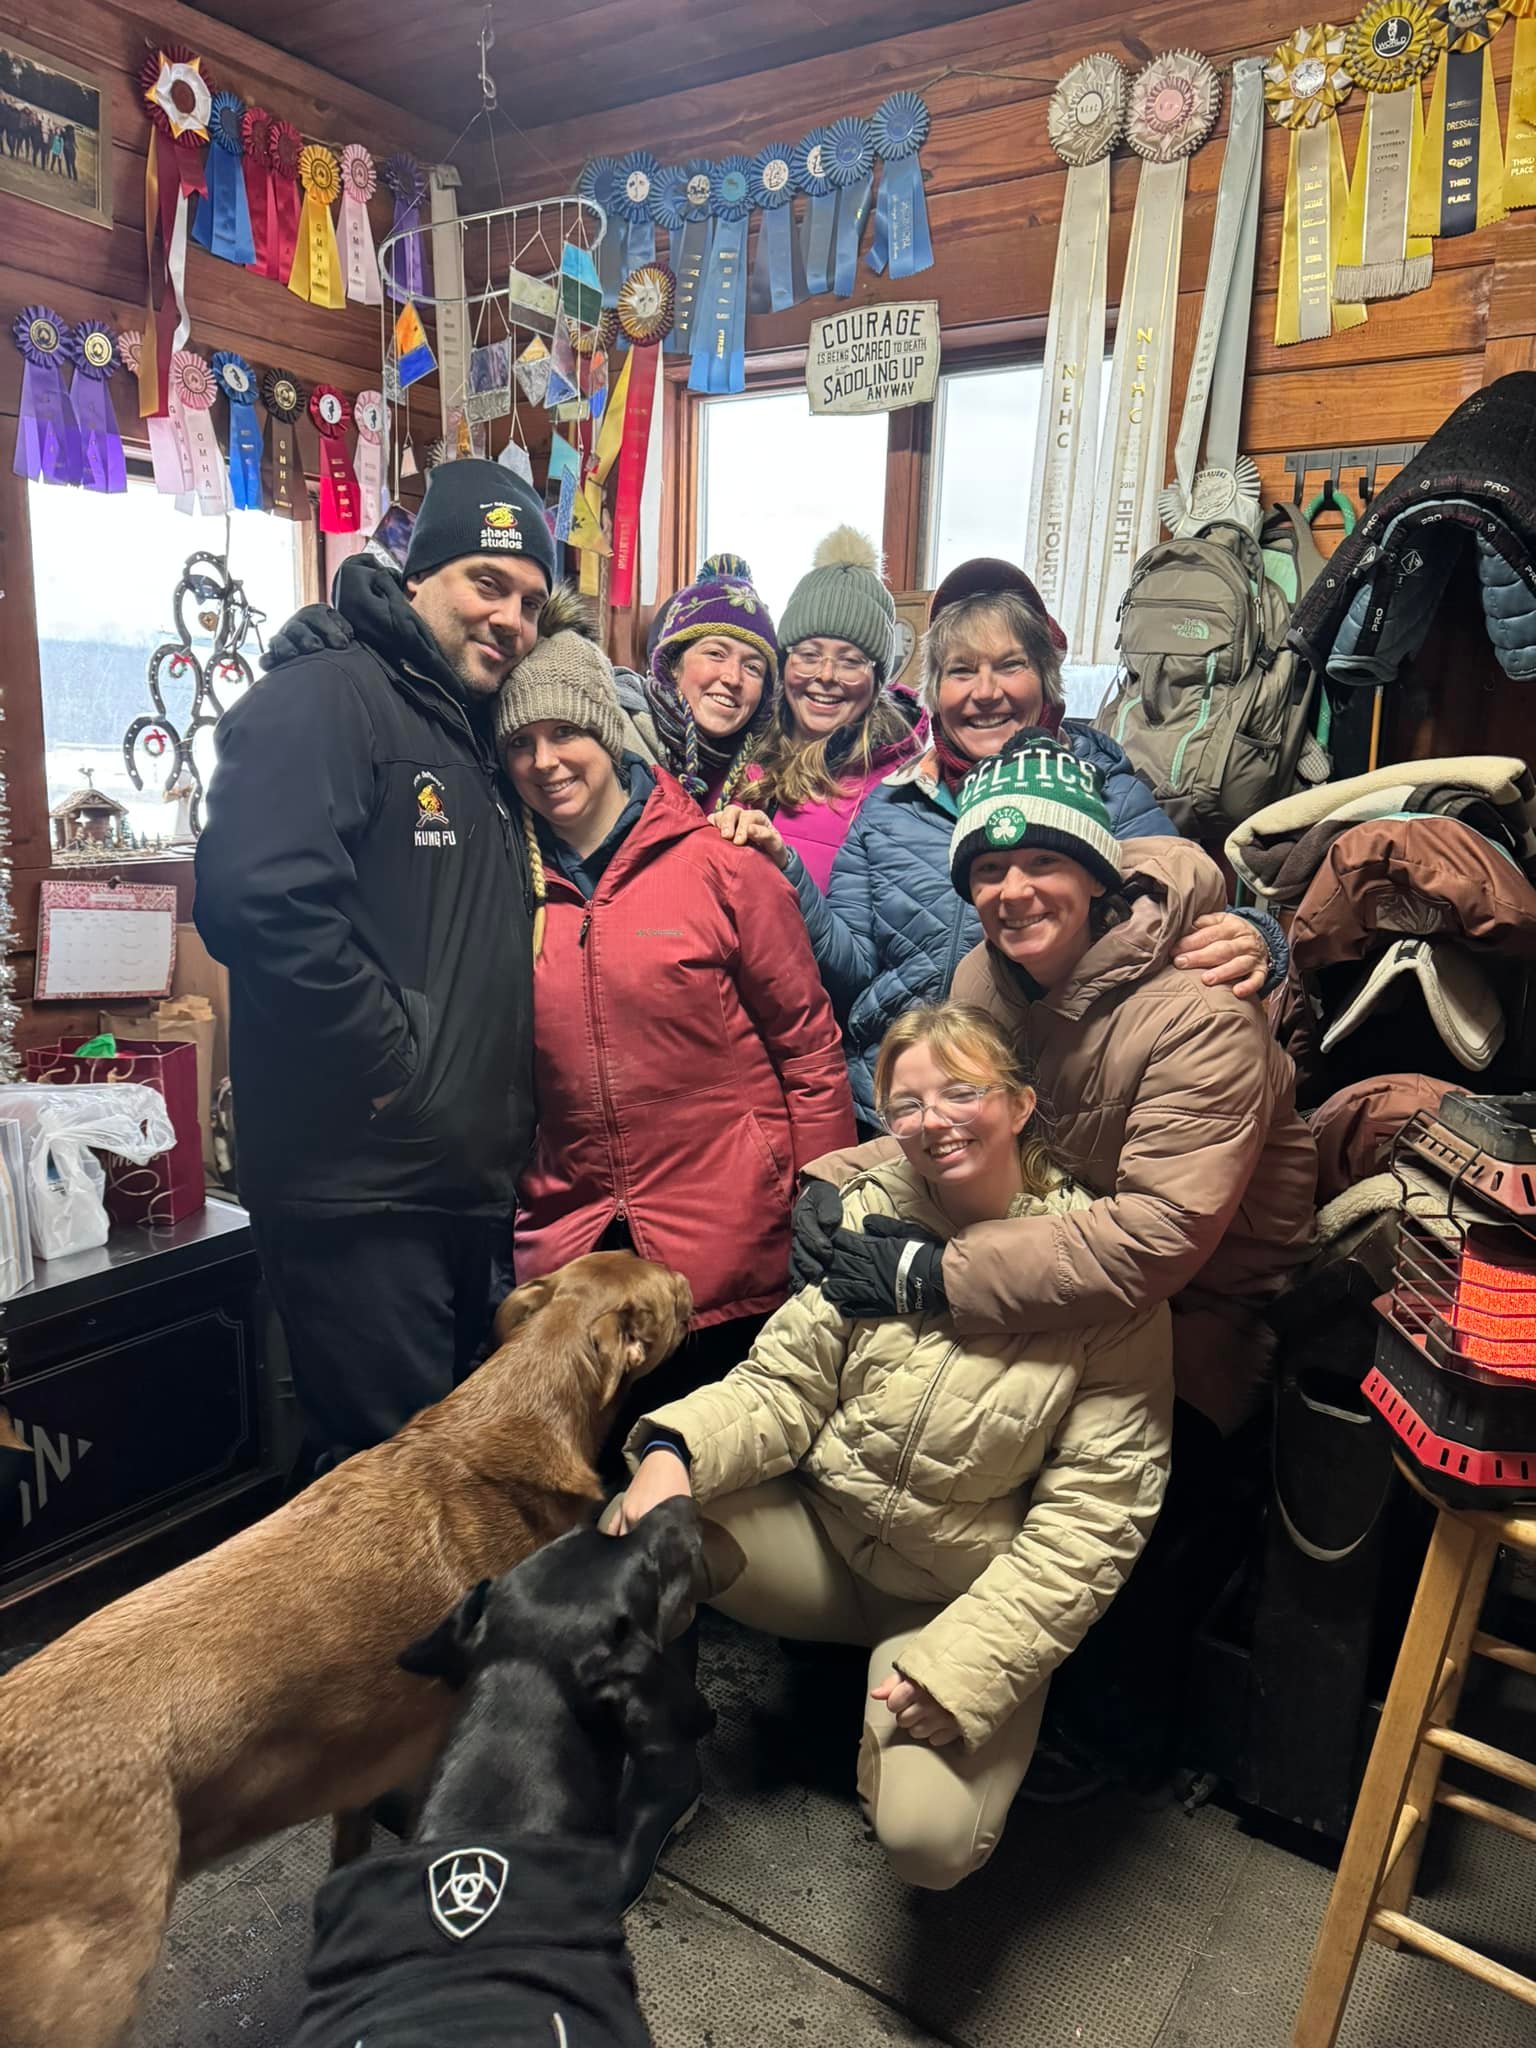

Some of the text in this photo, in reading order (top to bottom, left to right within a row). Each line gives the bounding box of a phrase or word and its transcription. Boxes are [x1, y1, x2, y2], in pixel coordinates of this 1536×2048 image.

[1446, 117, 1480, 132] DRESSAGE
[1511, 165, 1535, 176] PLACE
[1512, 156, 1535, 167] THIRD
[1449, 178, 1472, 188] THIRD
[1447, 193, 1472, 204] PLACE
[822, 309, 925, 349] COURAGE
[817, 337, 927, 365] IS BEING SCARED TO DEATH
[823, 355, 925, 405] SADDLING UP
[1128, 327, 1153, 424] NEHC
[866, 381, 915, 401] ANYWAY
[1057, 362, 1078, 449] NEHC
[1484, 480, 1511, 493] PRO
[480, 527, 523, 541] shaolin
[1112, 500, 1134, 555] FIFTH
[1361, 513, 1380, 537] PRO
[480, 538, 523, 550] studios
[1041, 521, 1062, 605] FOURTH
[1371, 607, 1385, 633] PRO
[961, 748, 1097, 805] CELTICS
[989, 807, 1024, 826] CELTICS
[414, 830, 457, 847] KUNG FU
